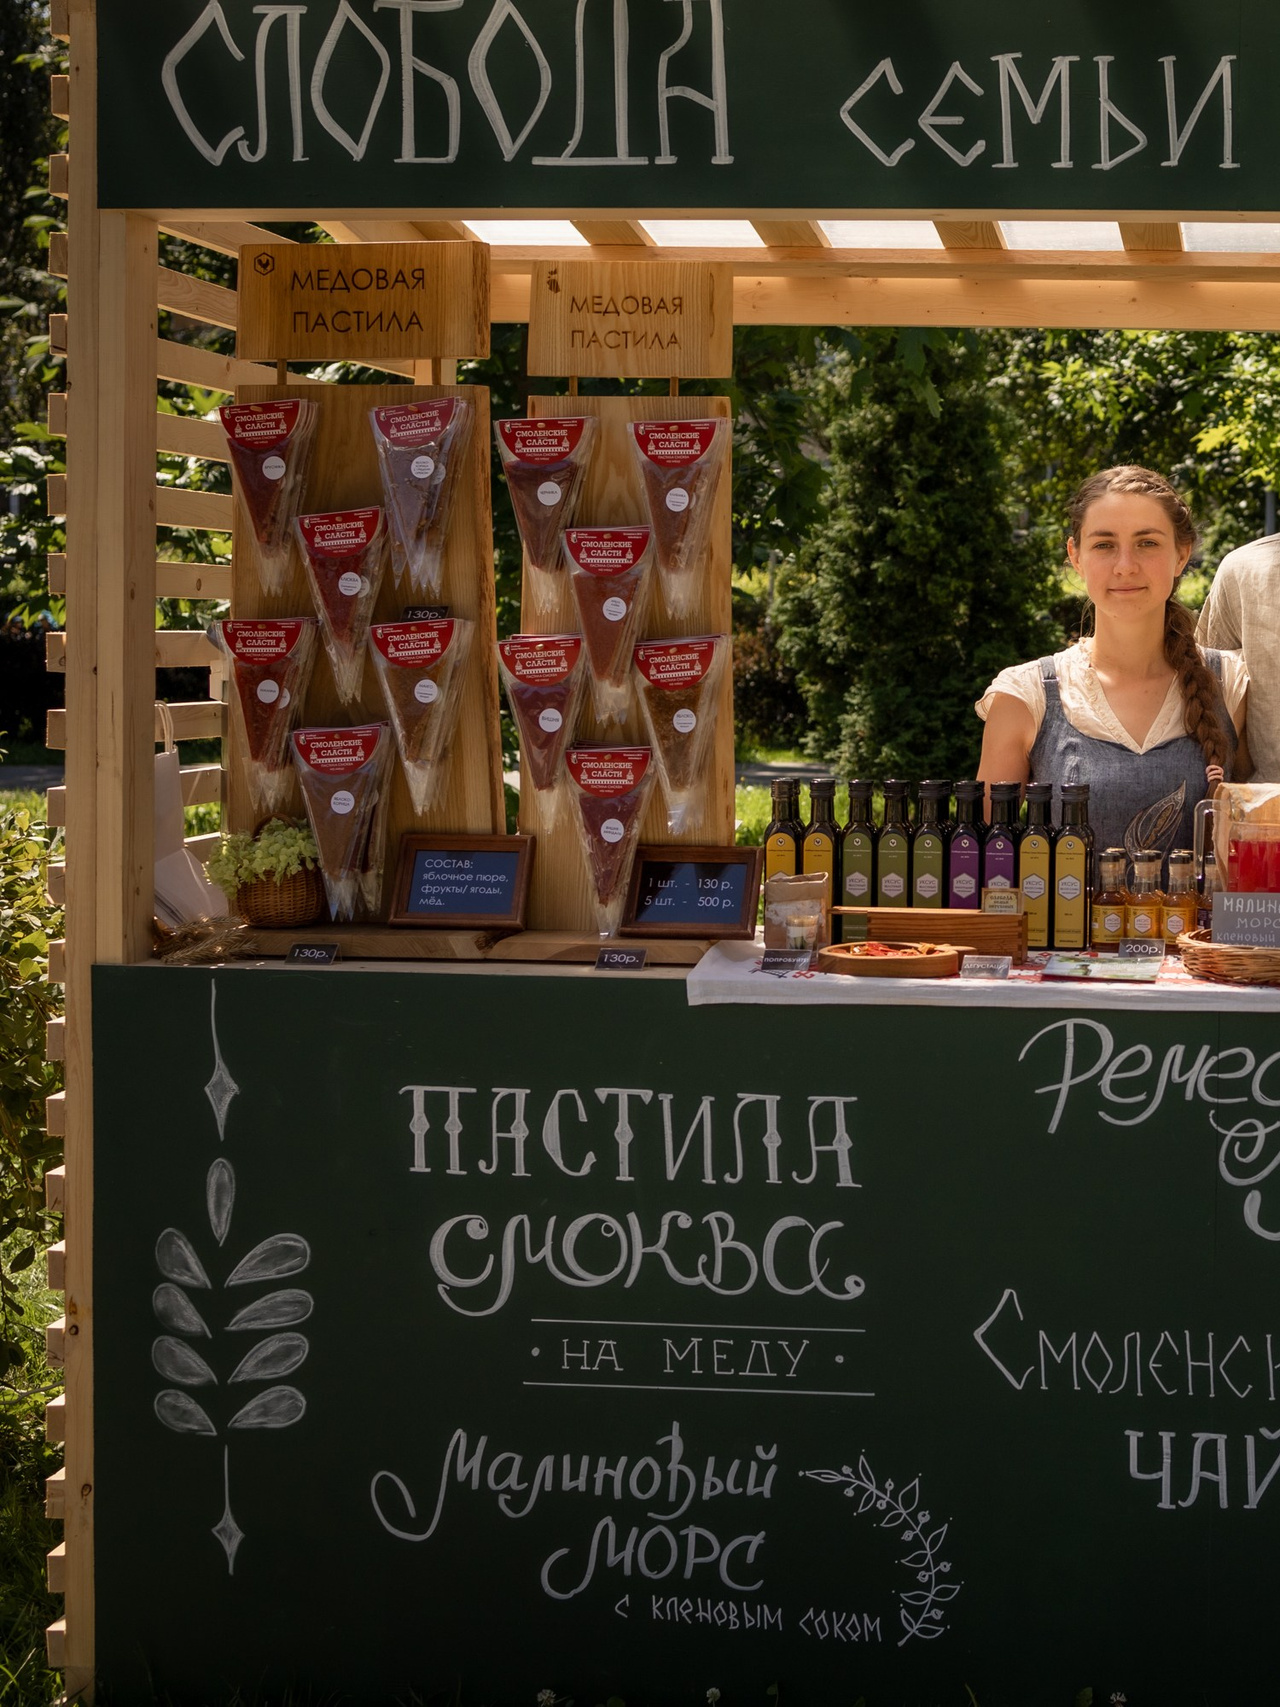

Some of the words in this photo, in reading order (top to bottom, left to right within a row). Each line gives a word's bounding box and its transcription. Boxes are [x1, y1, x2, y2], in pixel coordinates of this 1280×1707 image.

[161, 0, 735, 166] СЛОБОДА
[839, 52, 1242, 171] СЕМЬИ
[291, 267, 426, 294] МЕДОВАЯ
[570, 296, 684, 316] МЕДОВАЯ
[292, 310, 424, 333] ПАСТИЛА
[571, 329, 682, 350] ПАСТИЛА
[235, 411, 285, 423] СМОЛЕНСКИЕ
[390, 410, 440, 424] СМОЛЕНСКИЕ
[245, 421, 276, 430] СЛАСТИ
[400, 420, 430, 430] СЛАСТИ
[515, 429, 568, 438] СМОЛЕНСКИЕ
[648, 432, 700, 440] СМОЛЕНСКИЕ
[526, 438, 558, 446] СЛАСТИ
[314, 521, 365, 532] СМОЛЕНСКИЕ
[324, 531, 356, 540] СЛАСТИ
[590, 549, 622, 557] СЛАСТИ
[407, 610, 442, 620] 130р.
[387, 631, 440, 642] СМОЛЕНСКИЕ
[398, 641, 430, 650] СЛАСТИ
[515, 650, 566, 660] СМОЛЕНСКИЕ
[648, 653, 700, 664] СМОЛЕНСКИЕ
[525, 659, 557, 667] СЛАСТИ
[659, 663, 691, 671] СЛАСТИ
[310, 739, 363, 749] СМОЛЕНСКИЕ
[320, 748, 353, 757] СЛАСТИ
[591, 770, 623, 778] СЛАСТИ
[424, 858, 474, 869] СОСТАВ:
[422, 871, 474, 882] яблочное
[476, 873, 509, 883] пюре,
[420, 884, 469, 895] фрукты/
[470, 885, 503, 895] ягоды,
[648, 878, 653, 888] 1
[657, 879, 678, 888] шт.
[698, 878, 719, 889] 130
[720, 880, 734, 891] р.
[418, 896, 446, 906] мёд.
[644, 895, 652, 906] 5
[655, 897, 676, 906] шт.
[697, 896, 720, 907] 500
[722, 899, 735, 909] р.
[293, 948, 330, 959] 130р.
[1125, 943, 1162, 955] 200р.
[602, 953, 640, 964] 130р.
[398, 1085, 862, 1188] ПАСТИЛА
[561, 1338, 624, 1372] НА
[662, 1338, 810, 1377] МЕДУ
[370, 1420, 777, 1541] Малиновый
